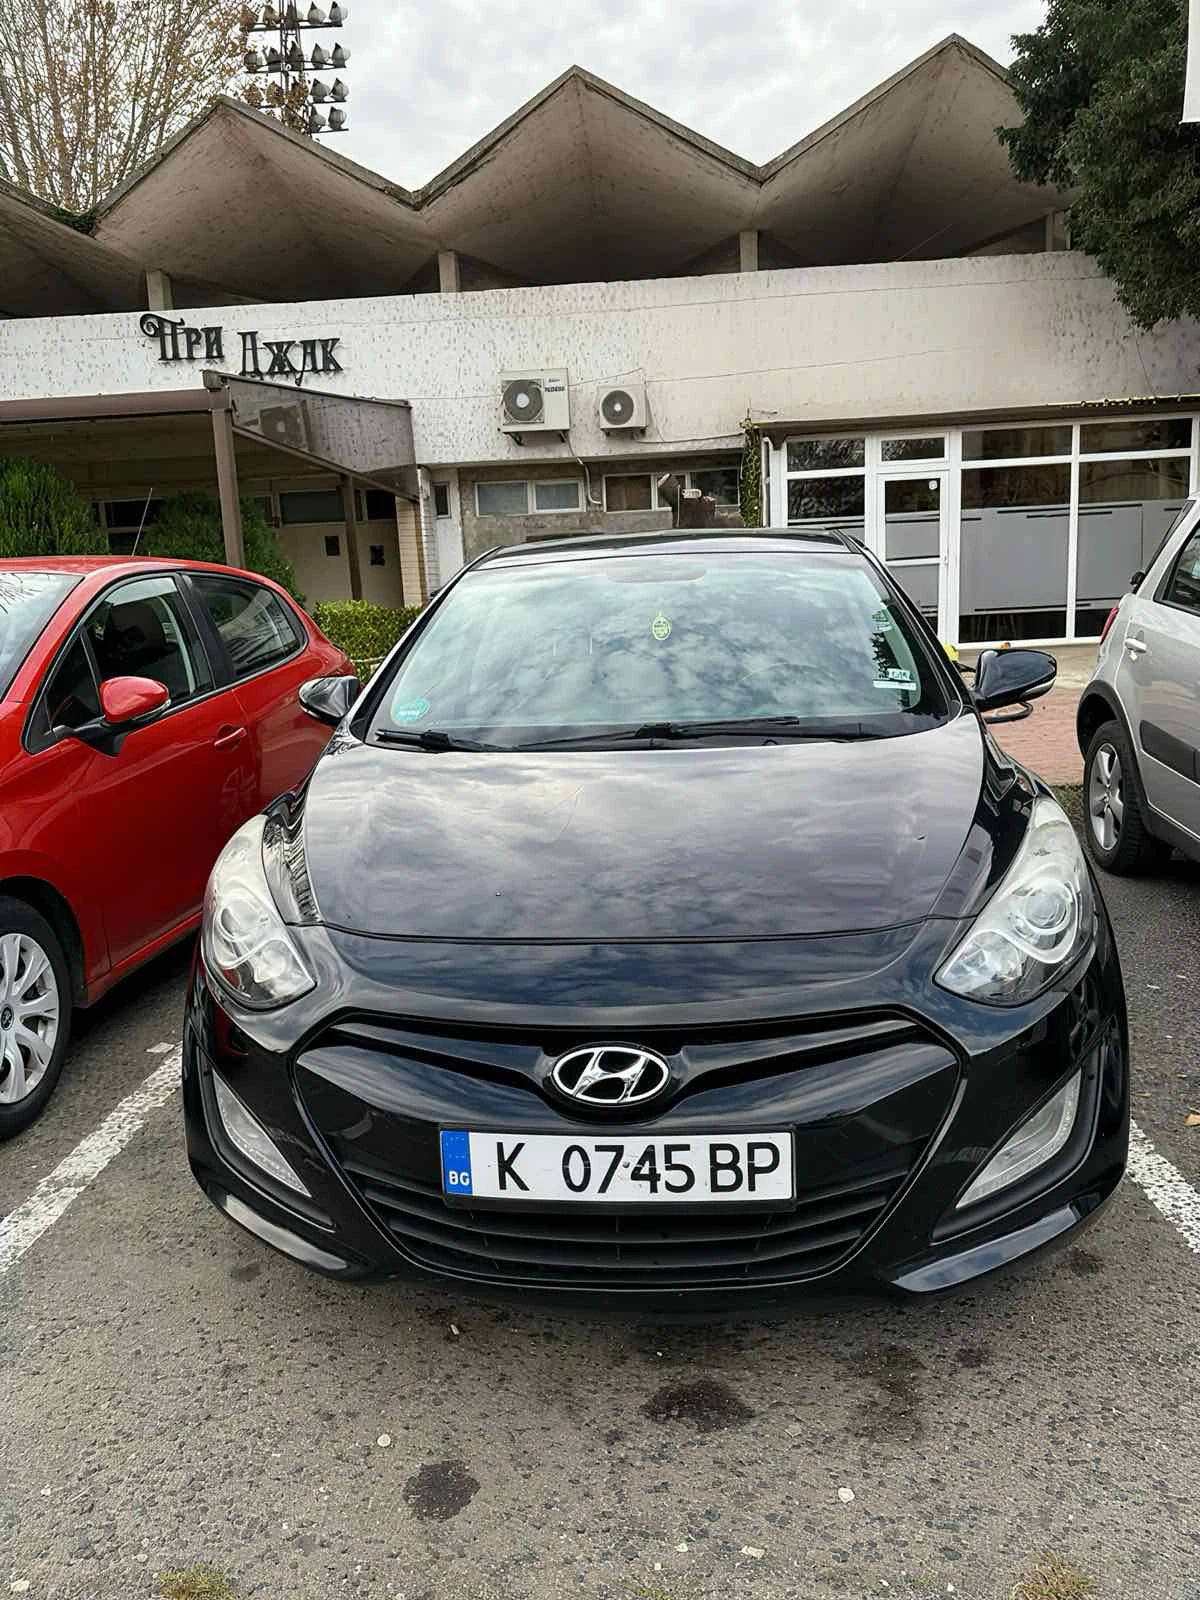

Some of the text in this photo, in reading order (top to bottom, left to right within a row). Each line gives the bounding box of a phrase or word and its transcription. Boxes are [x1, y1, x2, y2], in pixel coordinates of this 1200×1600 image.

[448, 1170, 470, 1187] BG
[496, 1141, 781, 1194] K 0745 BP
